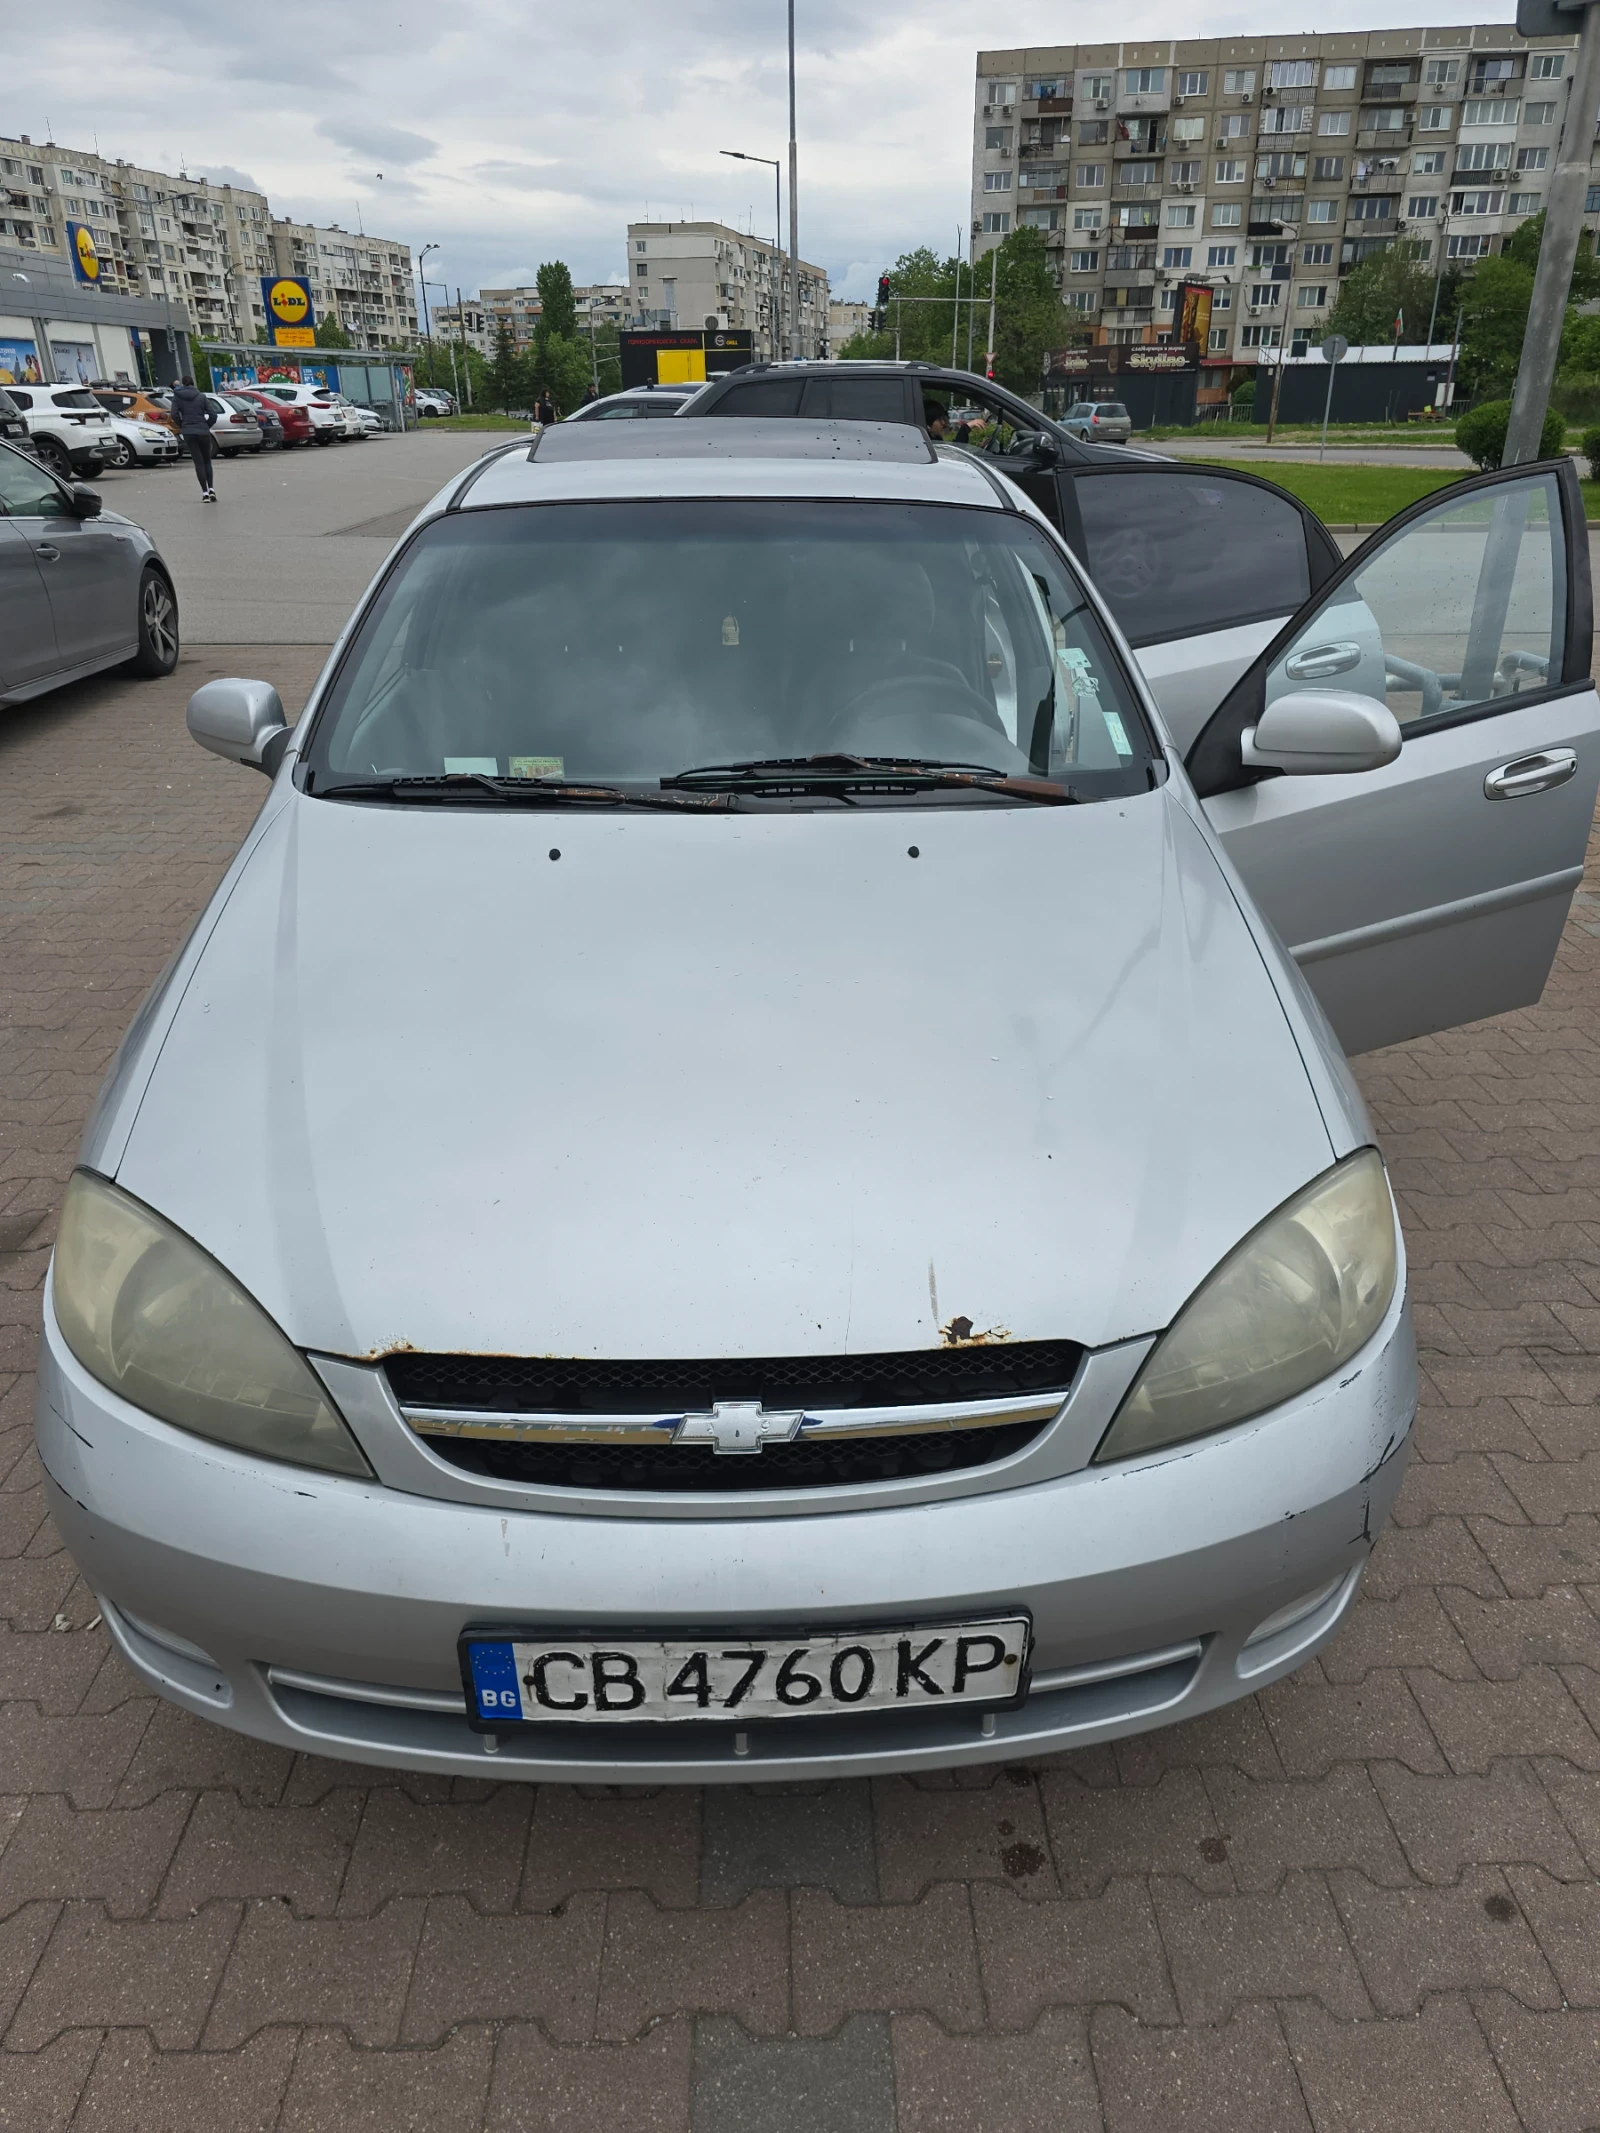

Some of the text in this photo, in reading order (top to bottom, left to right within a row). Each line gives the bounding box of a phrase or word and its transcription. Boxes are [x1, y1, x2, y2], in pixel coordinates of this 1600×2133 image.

[273, 292, 306, 308] LIDL
[1130, 353, 1186, 371] Skyline
[533, 1634, 1006, 1712] CB 4760 KP
[481, 1689, 517, 1708] BG
